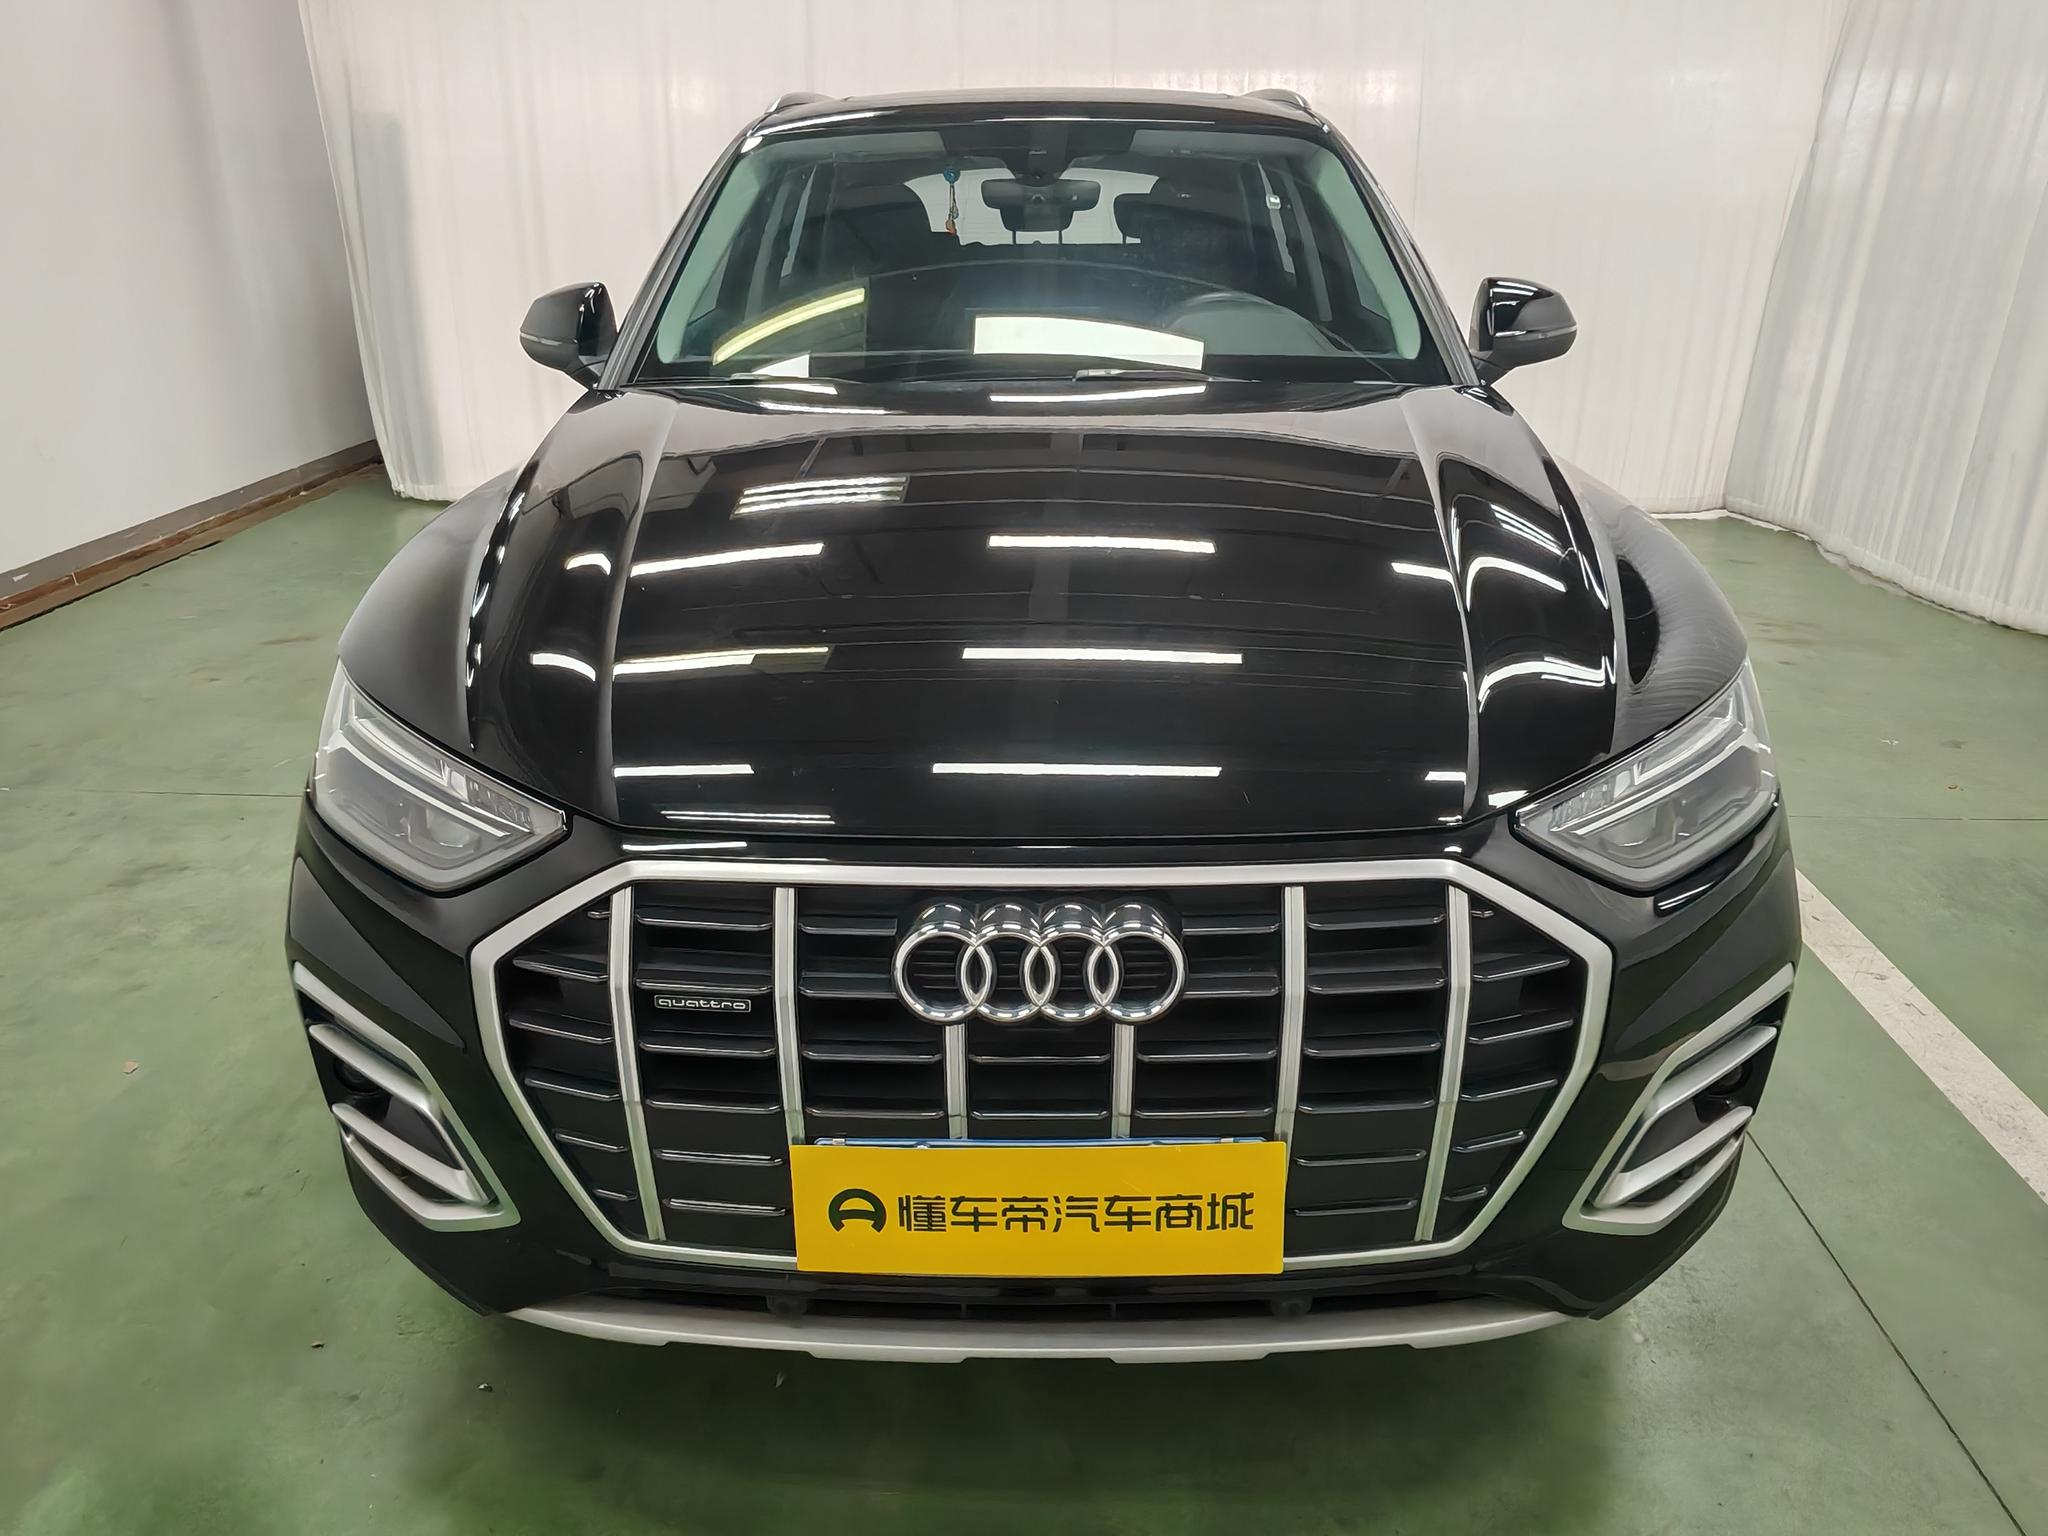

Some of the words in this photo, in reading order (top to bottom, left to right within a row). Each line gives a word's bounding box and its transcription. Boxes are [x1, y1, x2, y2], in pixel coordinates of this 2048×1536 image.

[658, 998, 746, 1010] quattro
[897, 1191, 1255, 1233] 懂车帝汽车商城
